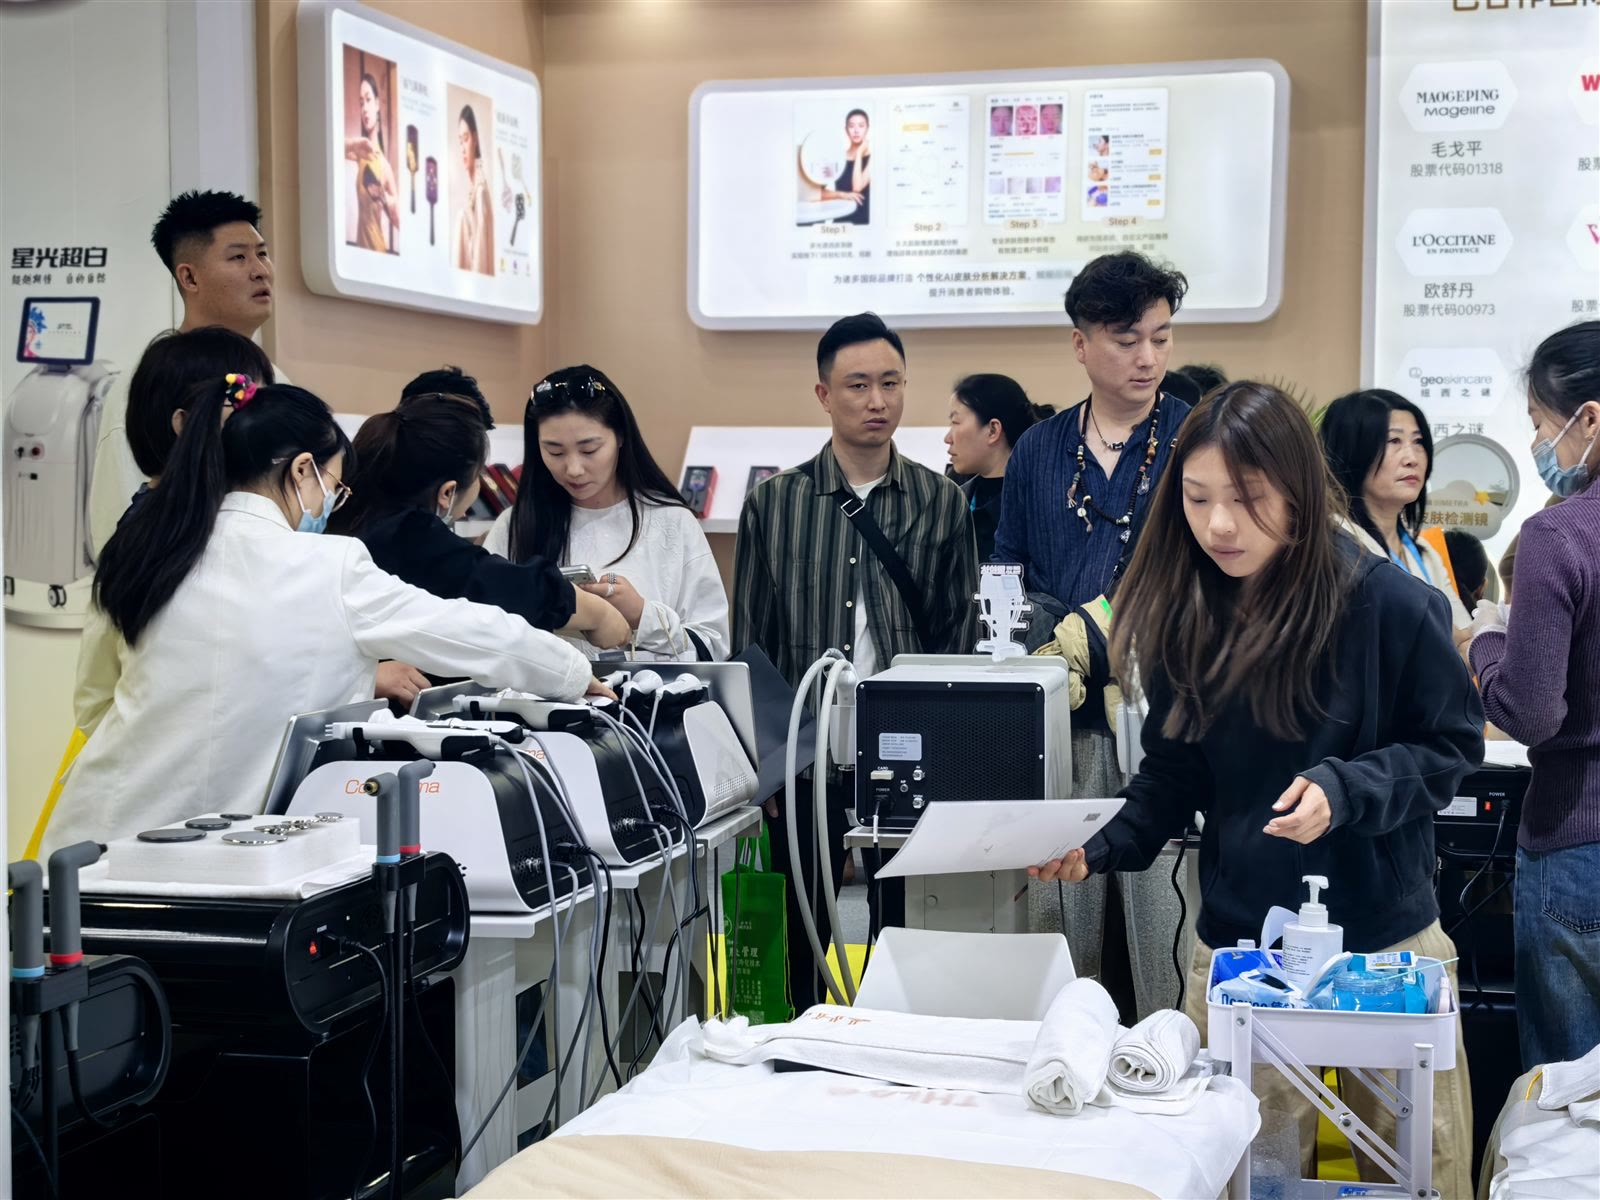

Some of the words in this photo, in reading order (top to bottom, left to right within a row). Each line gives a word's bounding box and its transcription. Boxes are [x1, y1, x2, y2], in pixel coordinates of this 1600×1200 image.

[1416, 89, 1500, 104] MAOGEPING
[1431, 140, 1482, 158] 毛戈平
[1410, 162, 1503, 178] 股票代码01318
[914, 223, 934, 232] Step
[935, 223, 942, 231] 2
[1010, 220, 1030, 229] Step
[1109, 217, 1129, 226] Step
[1130, 217, 1137, 225] 4
[11, 246, 108, 269] 星光超白
[1424, 282, 1474, 299] 欧舒丹
[1403, 303, 1496, 318] 股票代码00973
[1420, 374, 1493, 387] geoskincare
[1428, 422, 1485, 437] 西之谜
